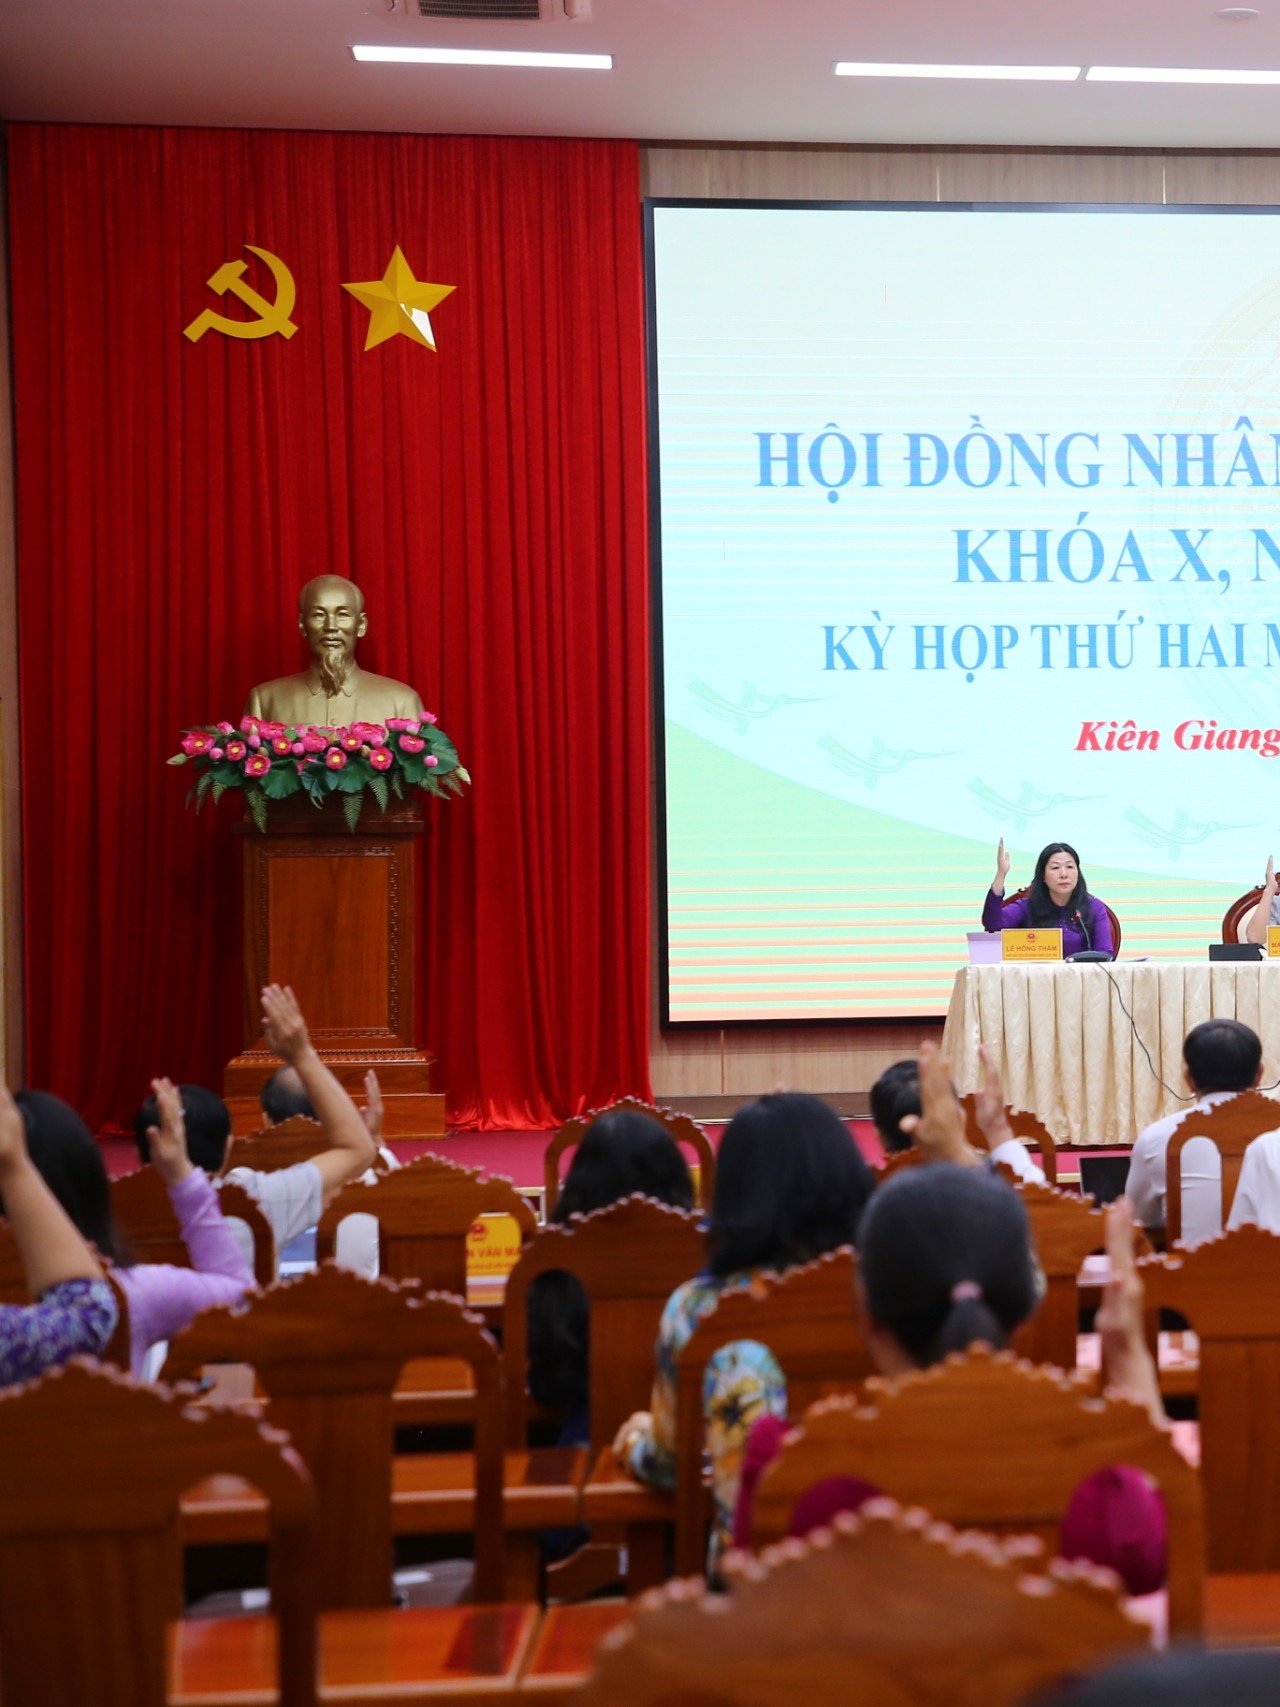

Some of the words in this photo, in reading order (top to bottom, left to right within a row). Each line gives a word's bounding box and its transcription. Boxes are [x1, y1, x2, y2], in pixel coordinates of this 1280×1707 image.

[754, 422, 885, 503] HỘI
[903, 415, 1103, 488] ĐỒNG
[952, 511, 1153, 584] KHÓA
[1169, 529, 1232, 594] X,
[822, 610, 895, 671] KỲ
[912, 624, 1019, 683] HỌP
[1030, 610, 1145, 669] THỨ
[1158, 623, 1246, 668] HAI
[1074, 718, 1161, 753] Kiên
